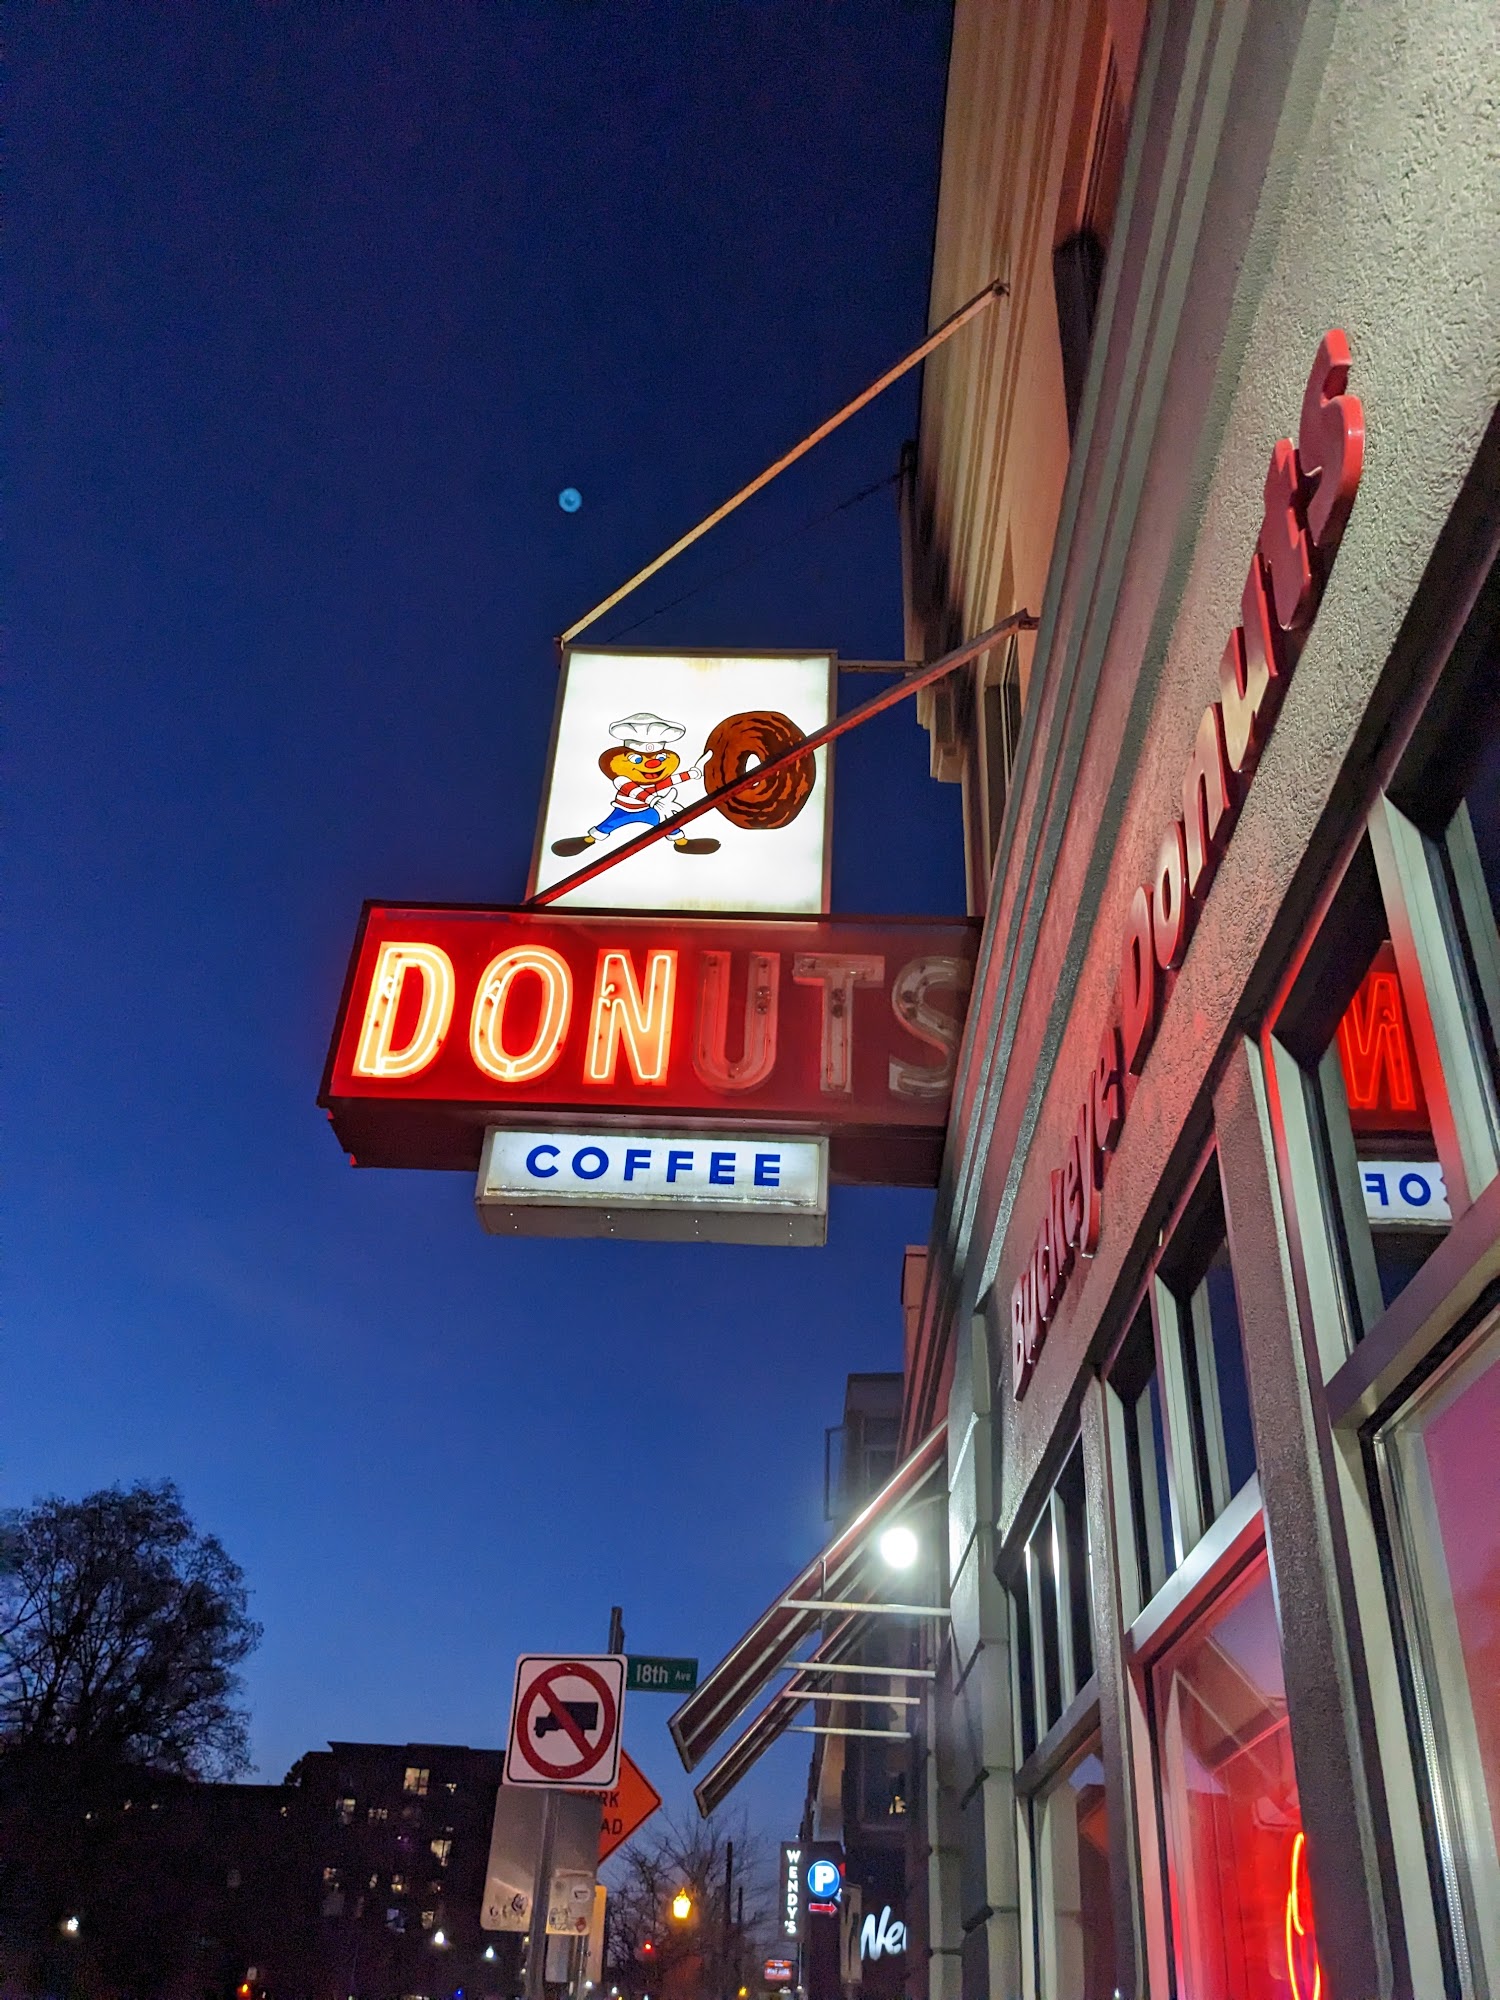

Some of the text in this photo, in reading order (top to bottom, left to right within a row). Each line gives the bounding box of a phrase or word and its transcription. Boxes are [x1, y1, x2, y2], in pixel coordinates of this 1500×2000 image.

[1012, 328, 1365, 1401] Buckeye Donuts
[352, 941, 971, 1098] DONUTS
[526, 1144, 781, 1187] COFFEE
[636, 1663, 692, 1684] 18th Ave
[784, 1849, 801, 1934] WENDY'S
[814, 1865, 835, 1892] P
[861, 1905, 907, 1961] Ne
